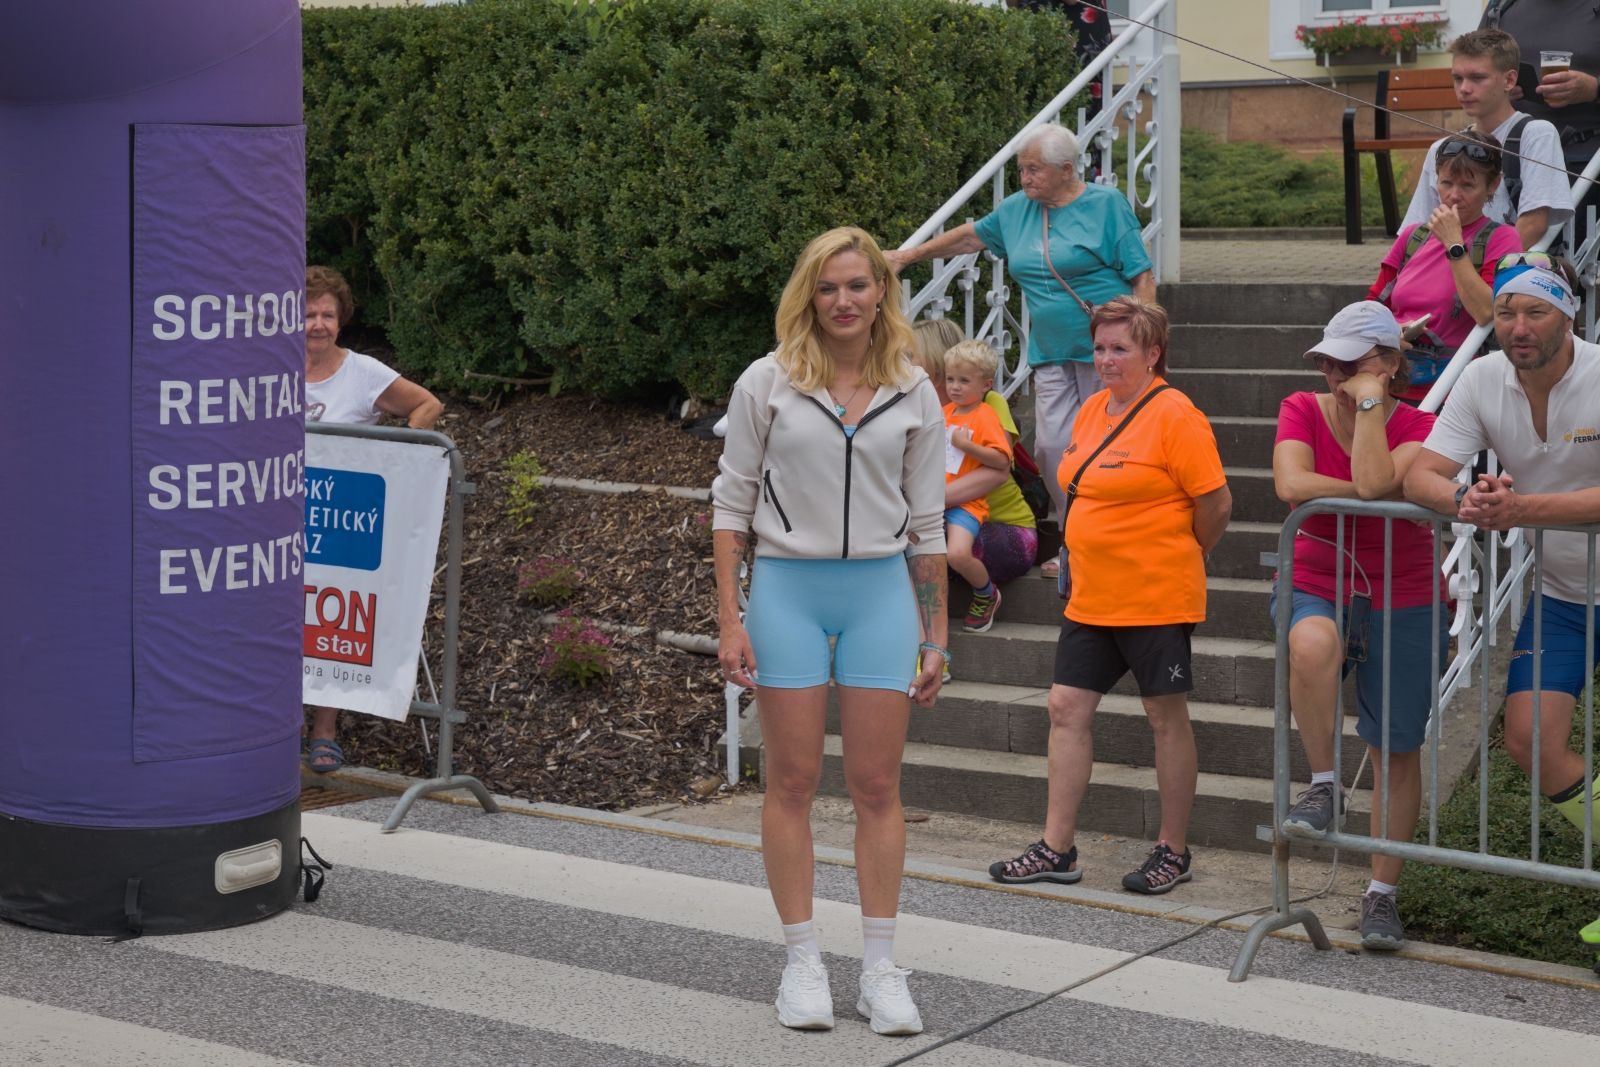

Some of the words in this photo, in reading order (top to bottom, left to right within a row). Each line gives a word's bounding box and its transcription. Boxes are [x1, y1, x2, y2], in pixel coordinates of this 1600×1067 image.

[153, 289, 304, 341] SCHOOL
[160, 371, 302, 425] RENTAL
[1574, 428, 1596, 437] ENNIO
[149, 449, 304, 510] SERVICE
[304, 506, 379, 533] ETICKÝ
[160, 531, 302, 594] EVENTS
[316, 634, 368, 657] stav
[333, 664, 372, 684] Úpice
